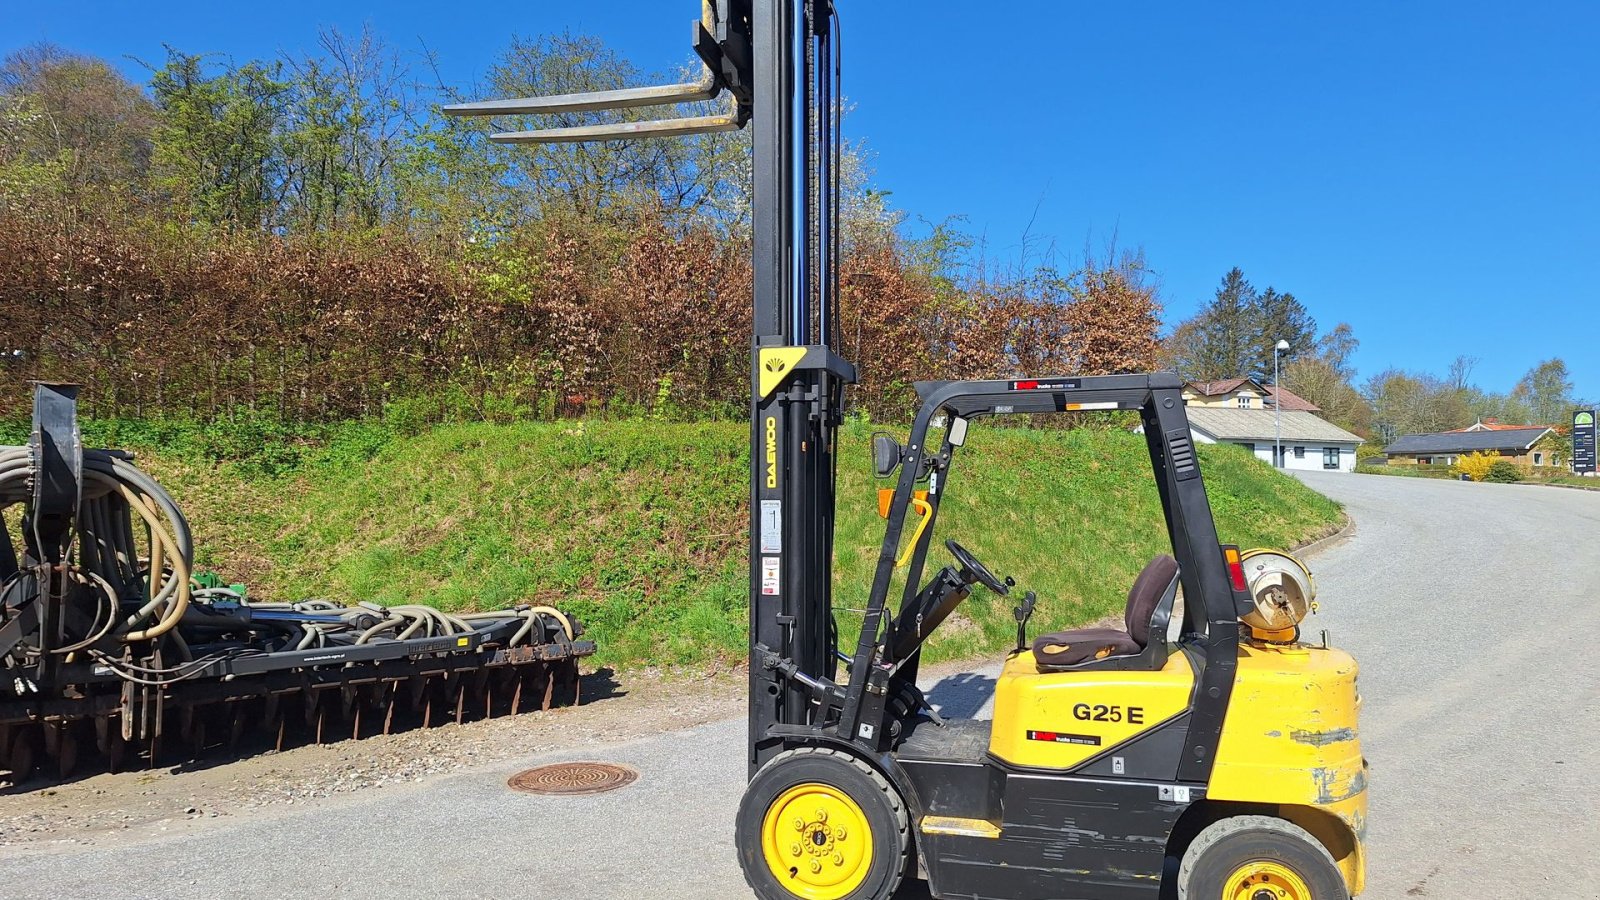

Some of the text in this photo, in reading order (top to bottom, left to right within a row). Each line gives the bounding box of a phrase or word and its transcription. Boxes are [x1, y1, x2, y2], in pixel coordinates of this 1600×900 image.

[766, 416, 777, 489] DAEWOO
[1072, 703, 1144, 725] G25 E
